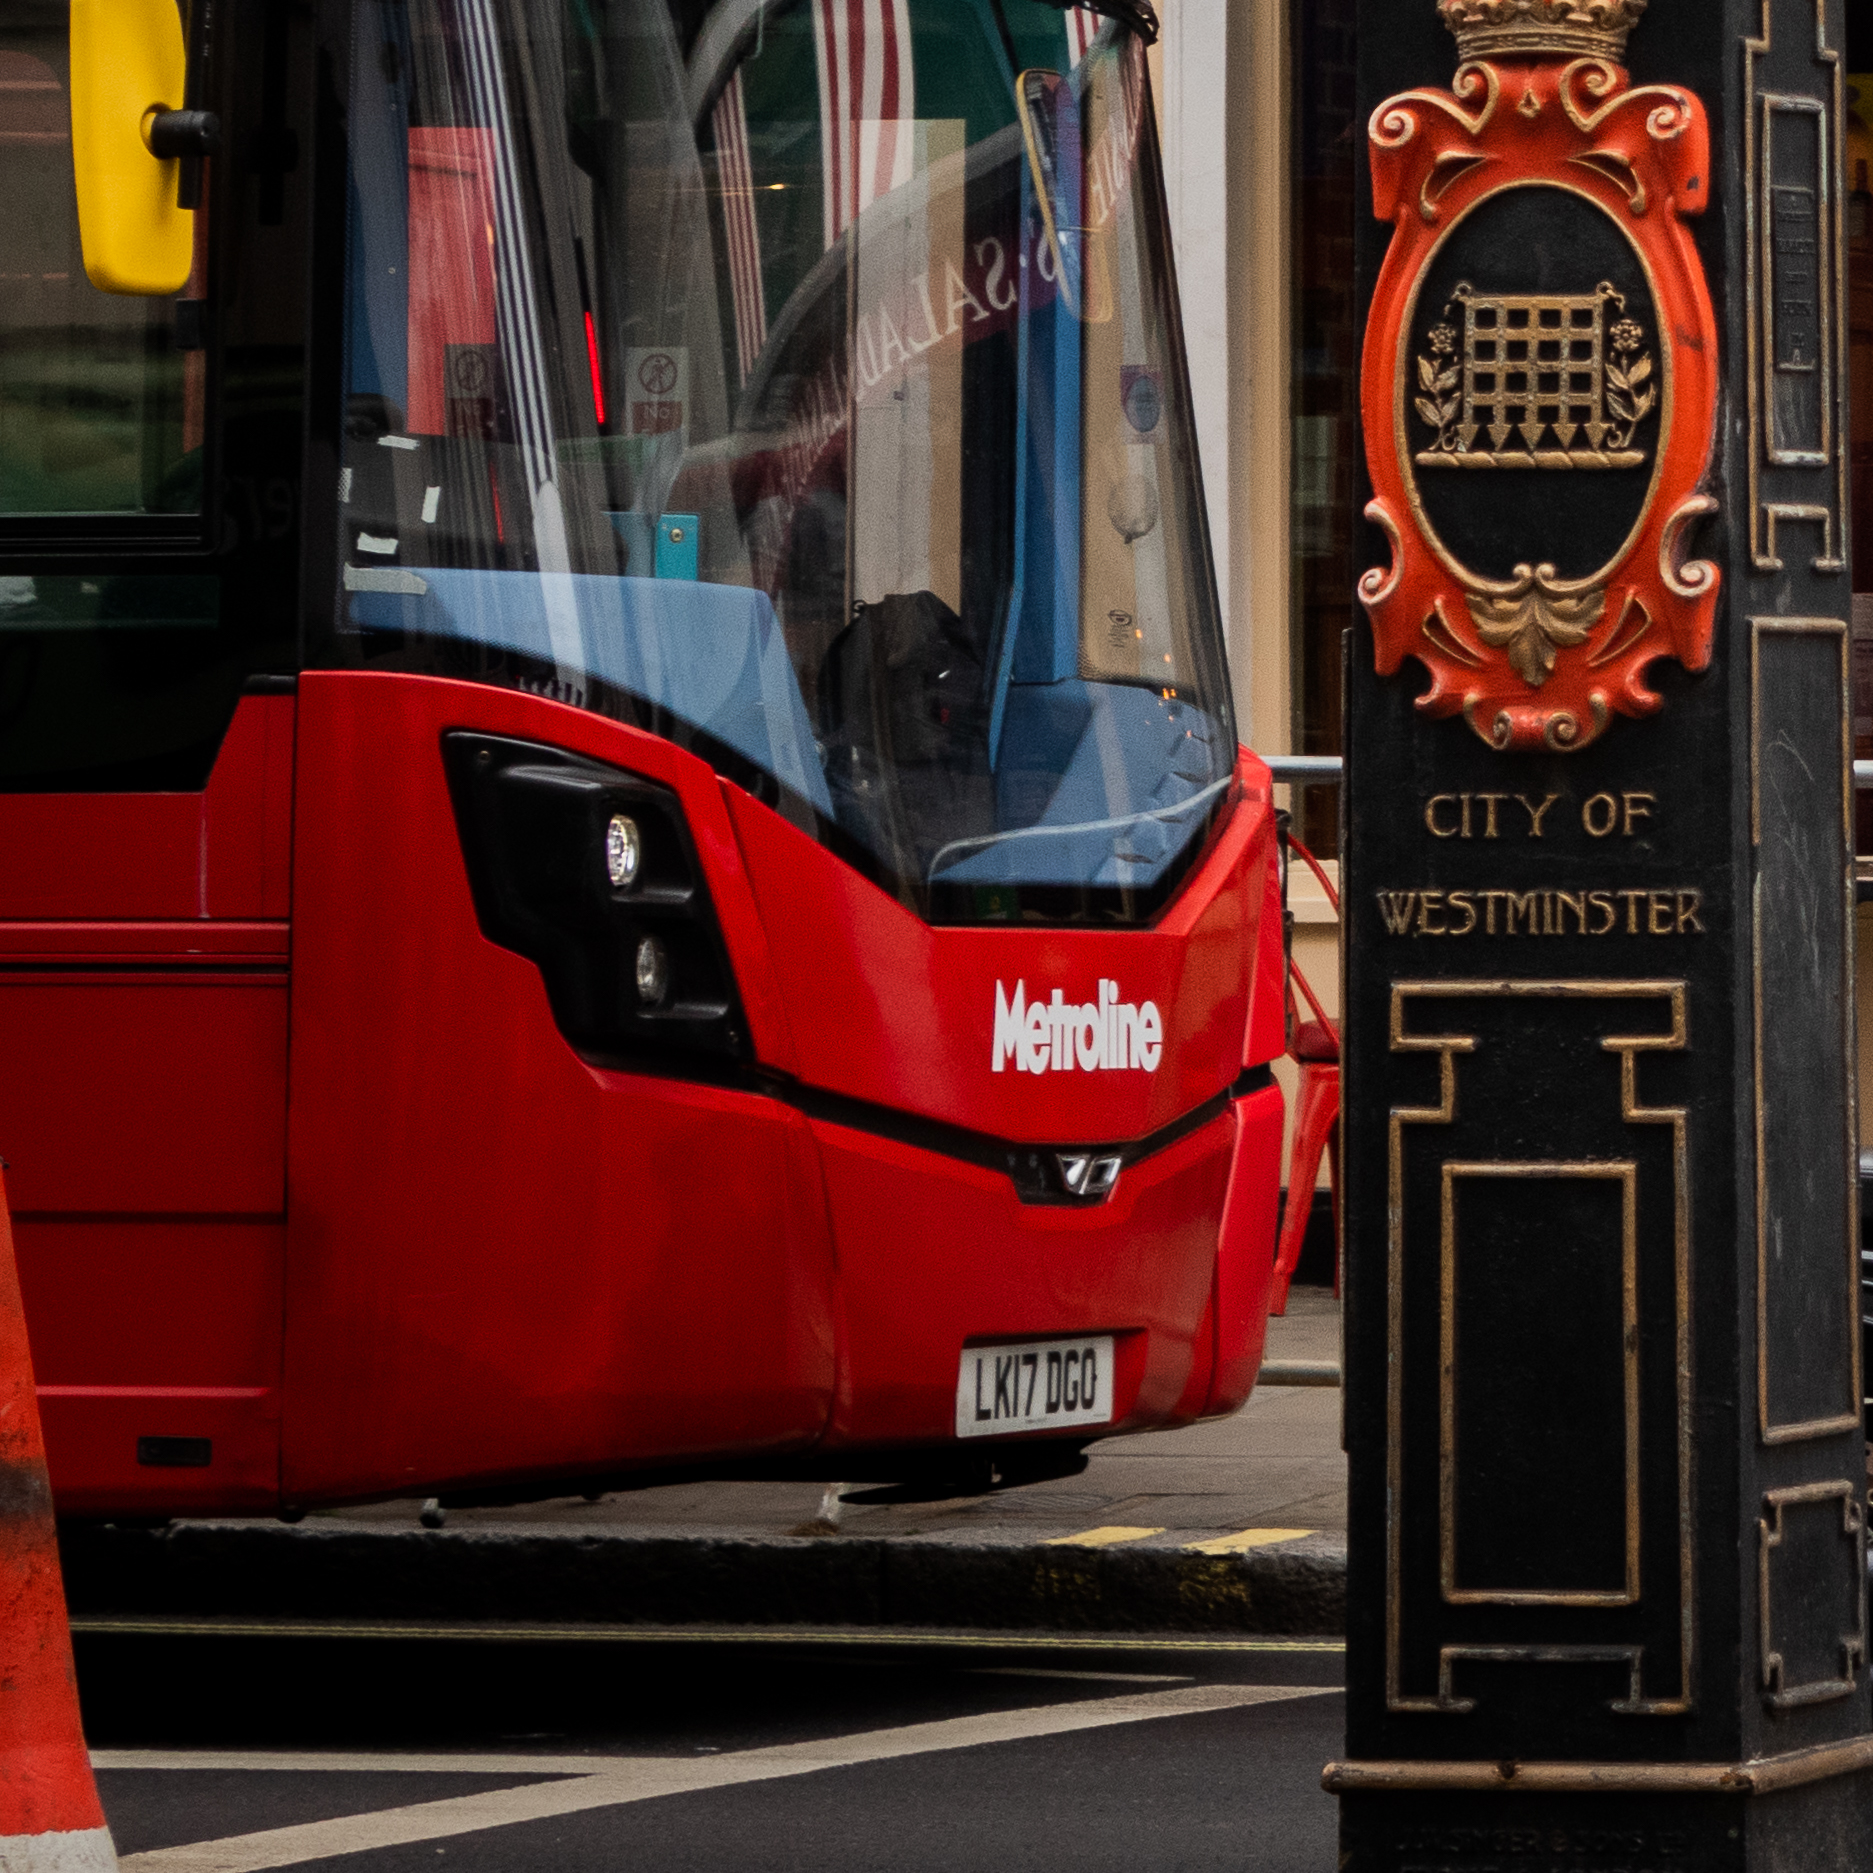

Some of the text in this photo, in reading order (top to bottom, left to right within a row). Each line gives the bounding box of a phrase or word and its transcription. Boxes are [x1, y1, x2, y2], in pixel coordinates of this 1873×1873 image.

[1424, 790, 1657, 839] CITY OF
[1375, 888, 1708, 937] WESTMINSTER
[991, 978, 1163, 1075] Metroline
[974, 1348, 1039, 1423] LK17
